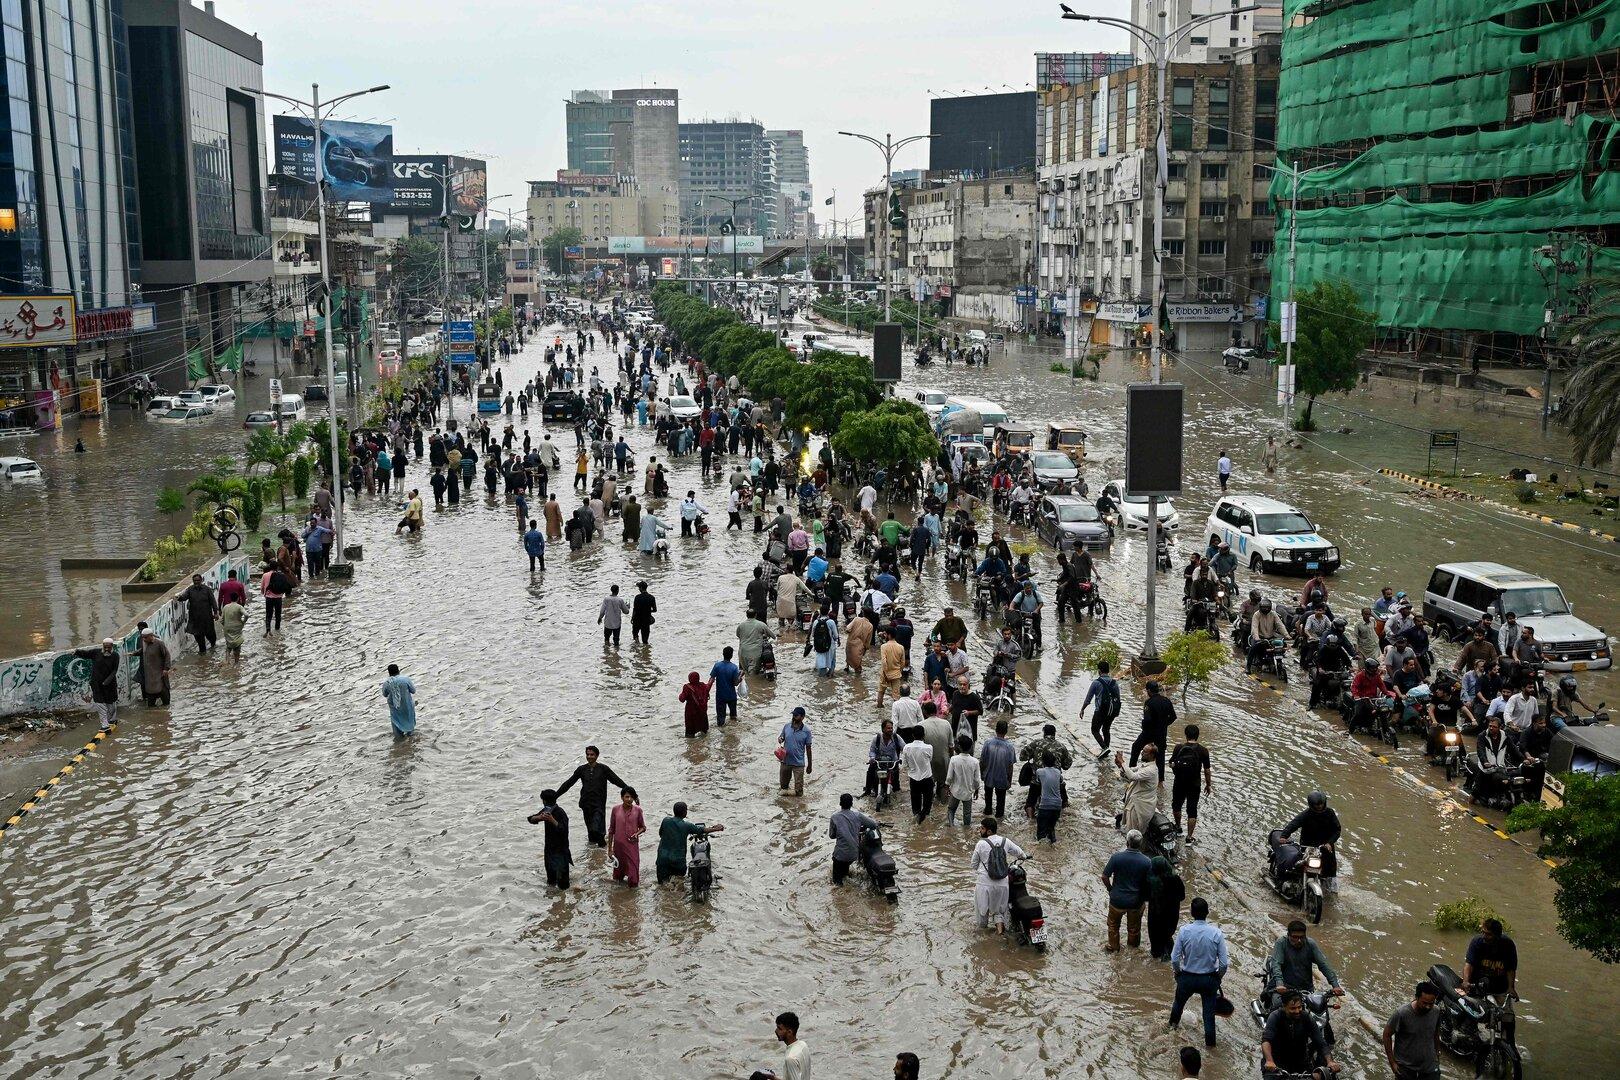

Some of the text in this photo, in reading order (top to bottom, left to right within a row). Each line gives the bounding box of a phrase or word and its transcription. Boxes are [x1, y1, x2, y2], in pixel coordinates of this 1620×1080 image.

[636, 99, 676, 107] CDC HOUSE
[392, 162, 434, 179] KFC
[1175, 306, 1203, 316] Ribbon
[1203, 305, 1230, 315] Bakers
[1275, 536, 1319, 544] UN
